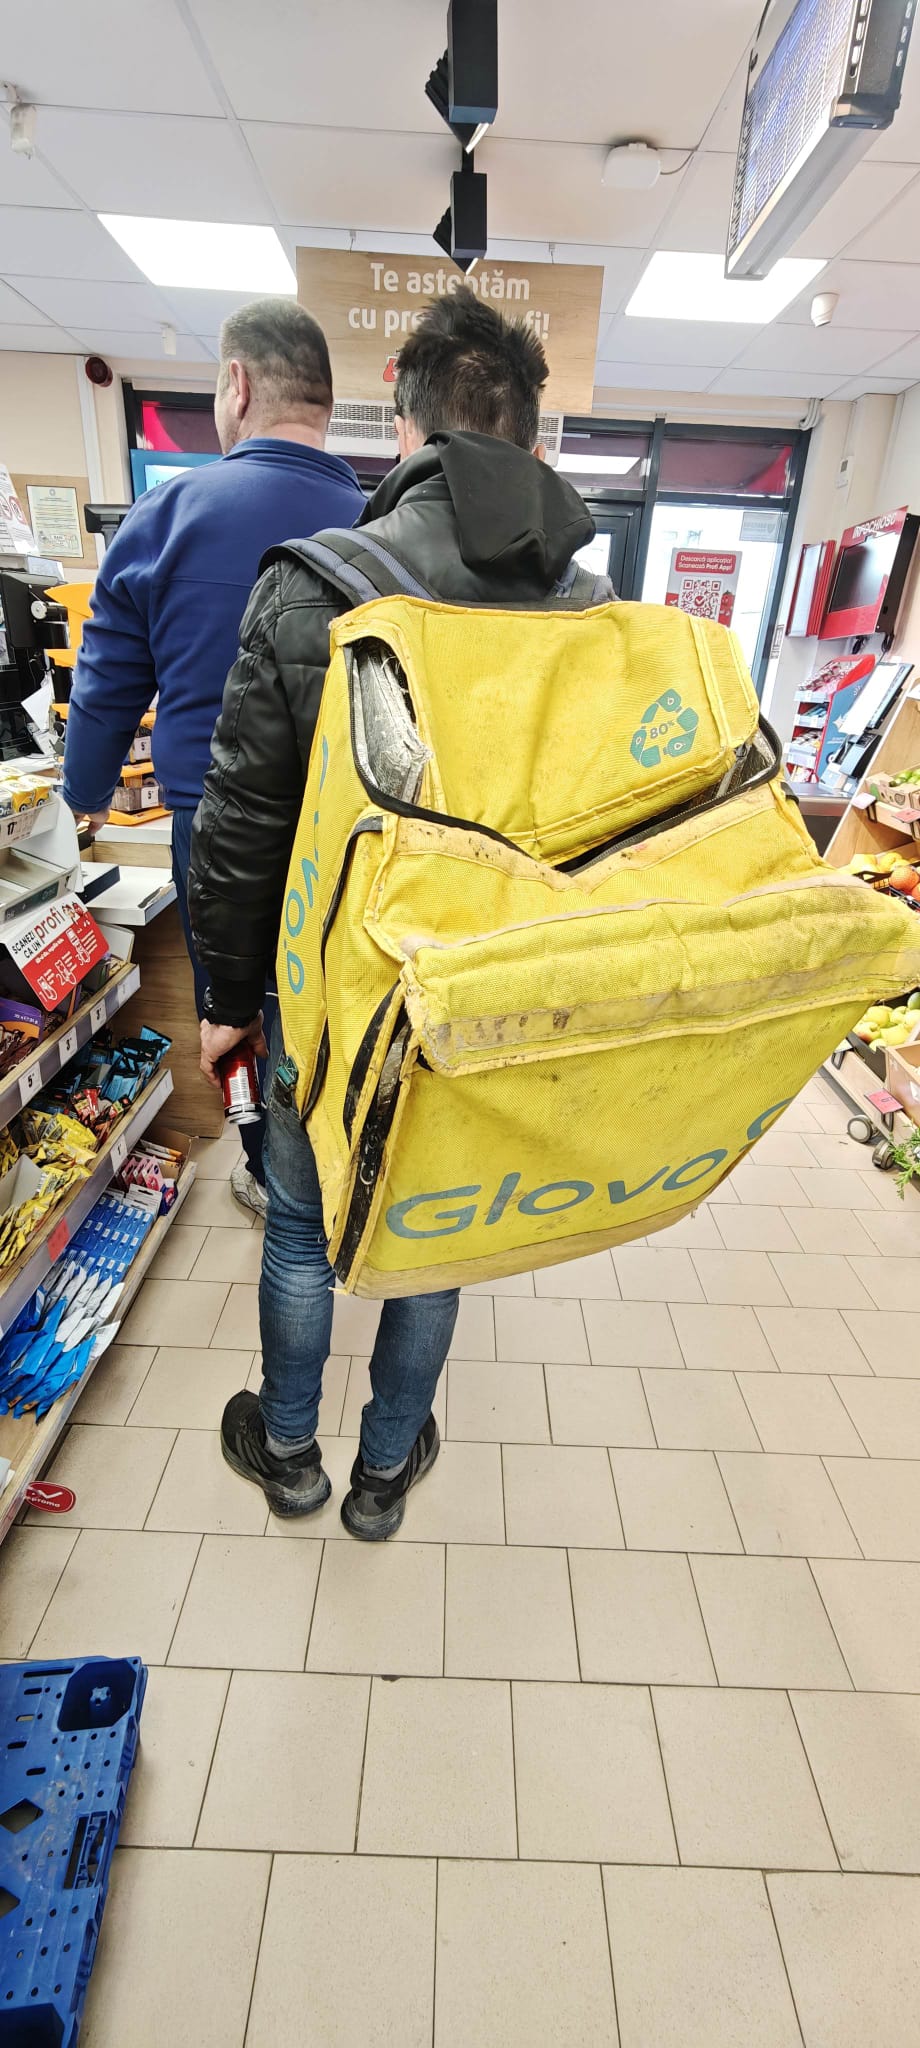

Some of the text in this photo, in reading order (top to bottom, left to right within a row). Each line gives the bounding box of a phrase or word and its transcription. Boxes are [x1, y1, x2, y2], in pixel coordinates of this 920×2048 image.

[370, 262, 399, 292] Te
[348, 307, 377, 330] cu
[34, 905, 66, 944] profi
[23, 945, 34, 959] CA
[385, 1148, 729, 1239] Glovo
